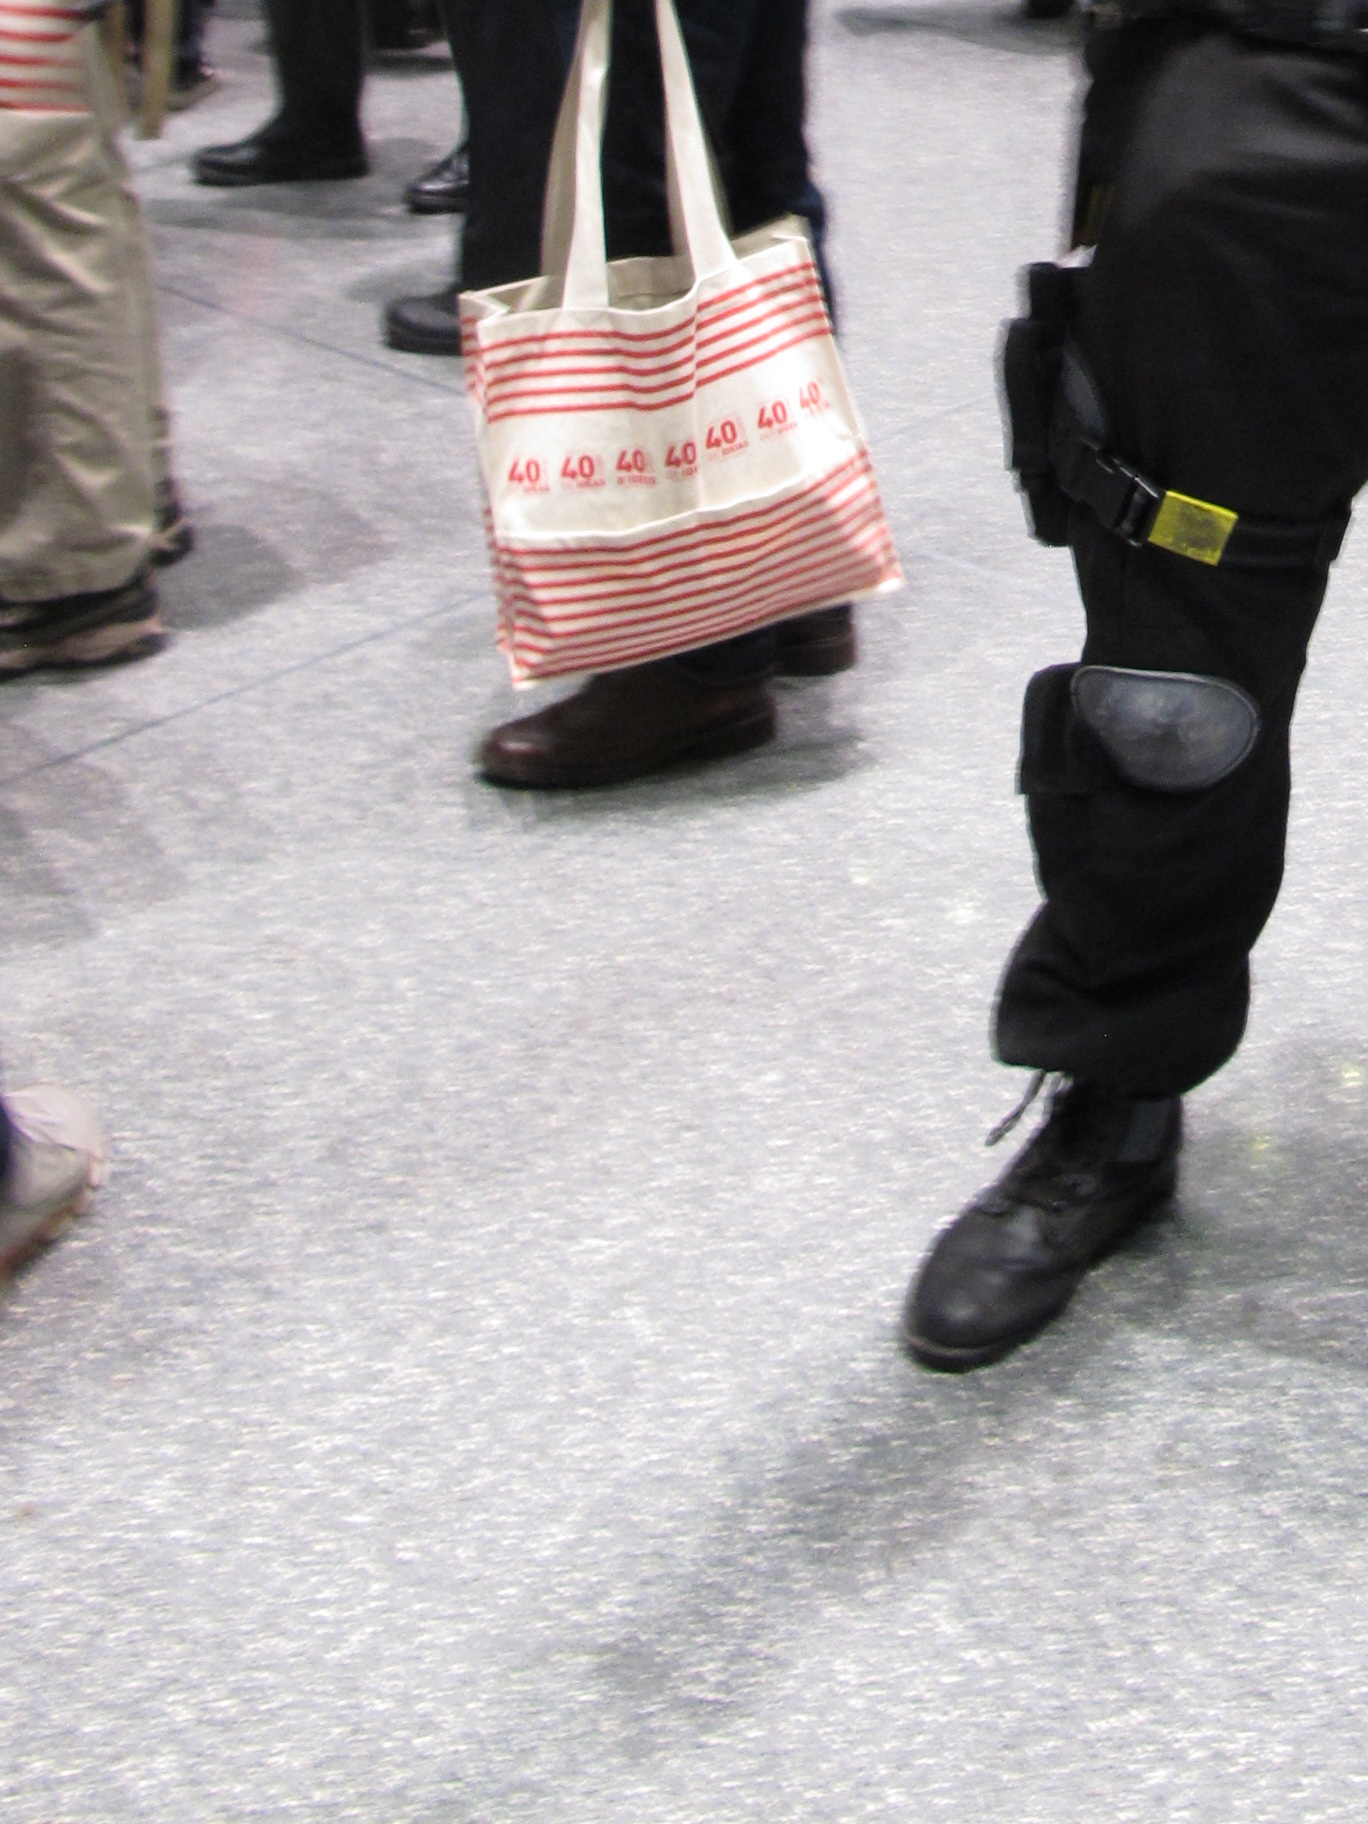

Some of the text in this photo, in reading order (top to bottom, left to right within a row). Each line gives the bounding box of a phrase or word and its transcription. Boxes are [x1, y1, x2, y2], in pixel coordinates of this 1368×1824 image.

[508, 457, 541, 484] 40
[560, 455, 595, 479] 40
[616, 449, 646, 473] 40
[664, 440, 698, 468] 40
[705, 420, 738, 450] 40
[757, 400, 788, 429] 40
[799, 381, 822, 410] 40
